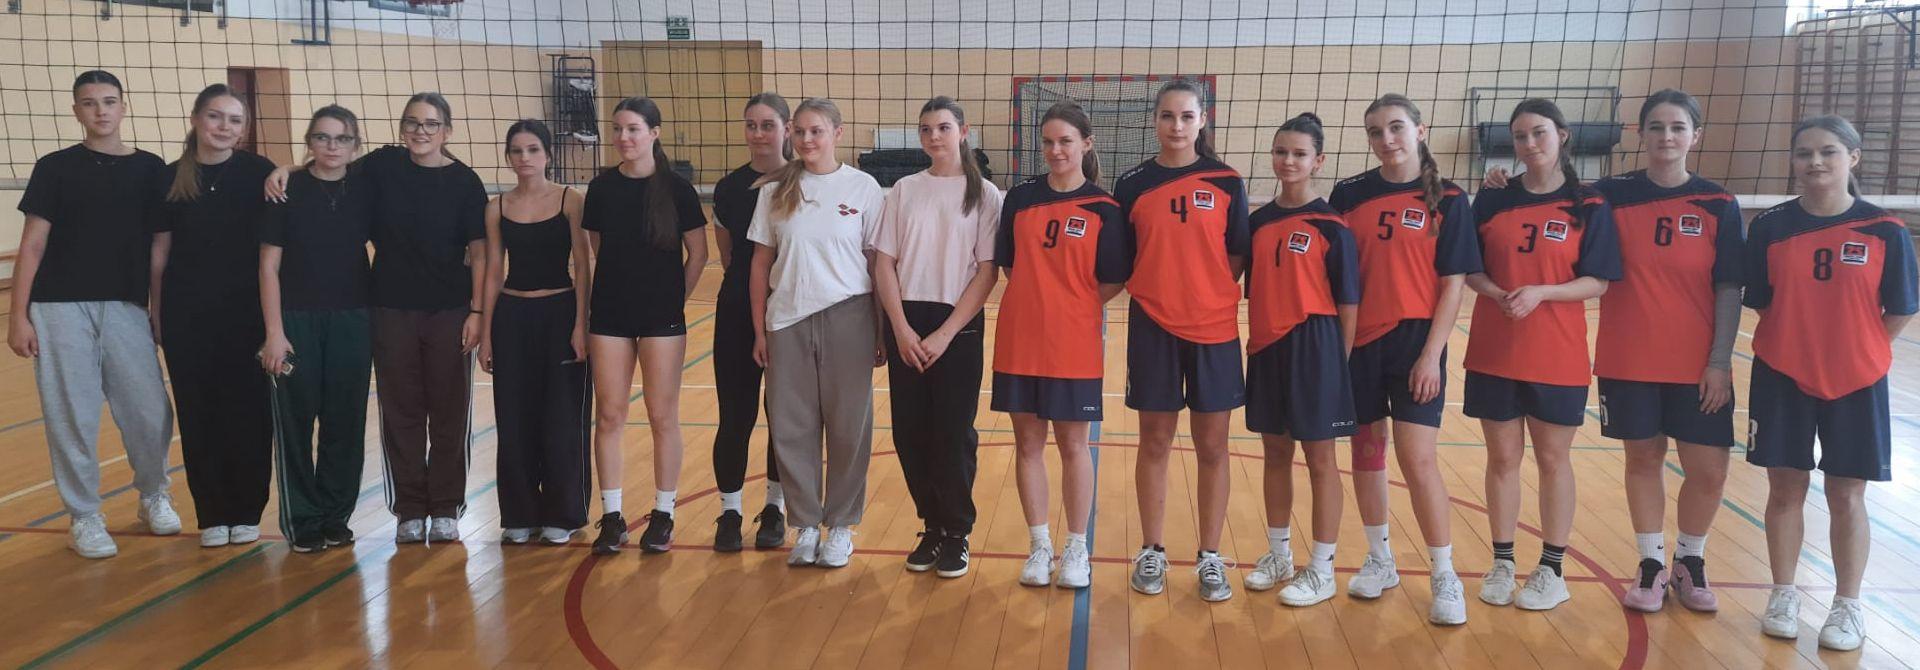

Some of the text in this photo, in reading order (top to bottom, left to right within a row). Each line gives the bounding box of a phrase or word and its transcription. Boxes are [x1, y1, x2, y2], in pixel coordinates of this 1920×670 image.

[1170, 195, 1188, 223] 4
[1043, 219, 1060, 248] 9
[1377, 211, 1397, 241] 5
[1518, 223, 1539, 253] 3
[1654, 217, 1673, 247] 6
[1275, 238, 1283, 267] 1
[1813, 248, 1833, 281] 8
